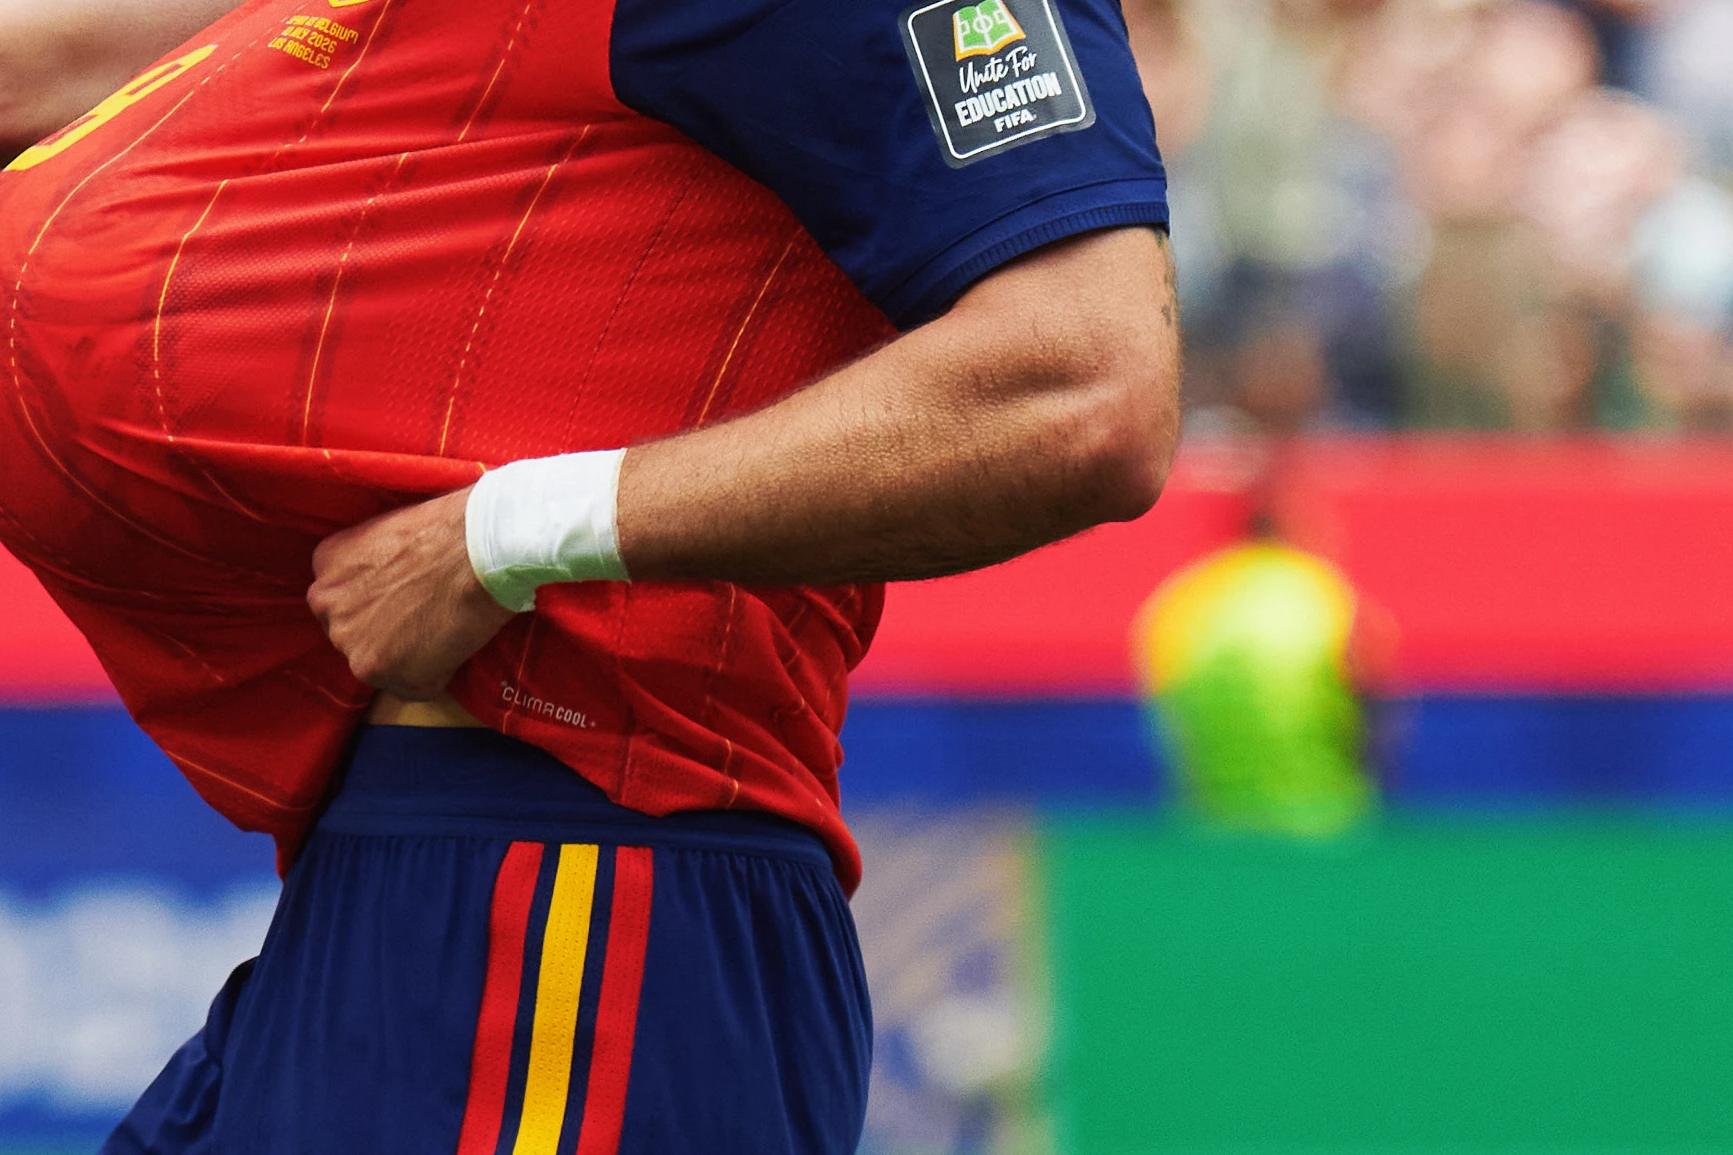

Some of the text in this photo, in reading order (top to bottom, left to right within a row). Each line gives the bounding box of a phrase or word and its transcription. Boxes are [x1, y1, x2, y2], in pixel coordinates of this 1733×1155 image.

[283, 39, 331, 69] ANGELES
[307, 31, 338, 54] 2026
[959, 46, 1037, 94] Unite For
[954, 71, 1063, 128] EDUCATION
[993, 108, 1035, 133] FIFA
